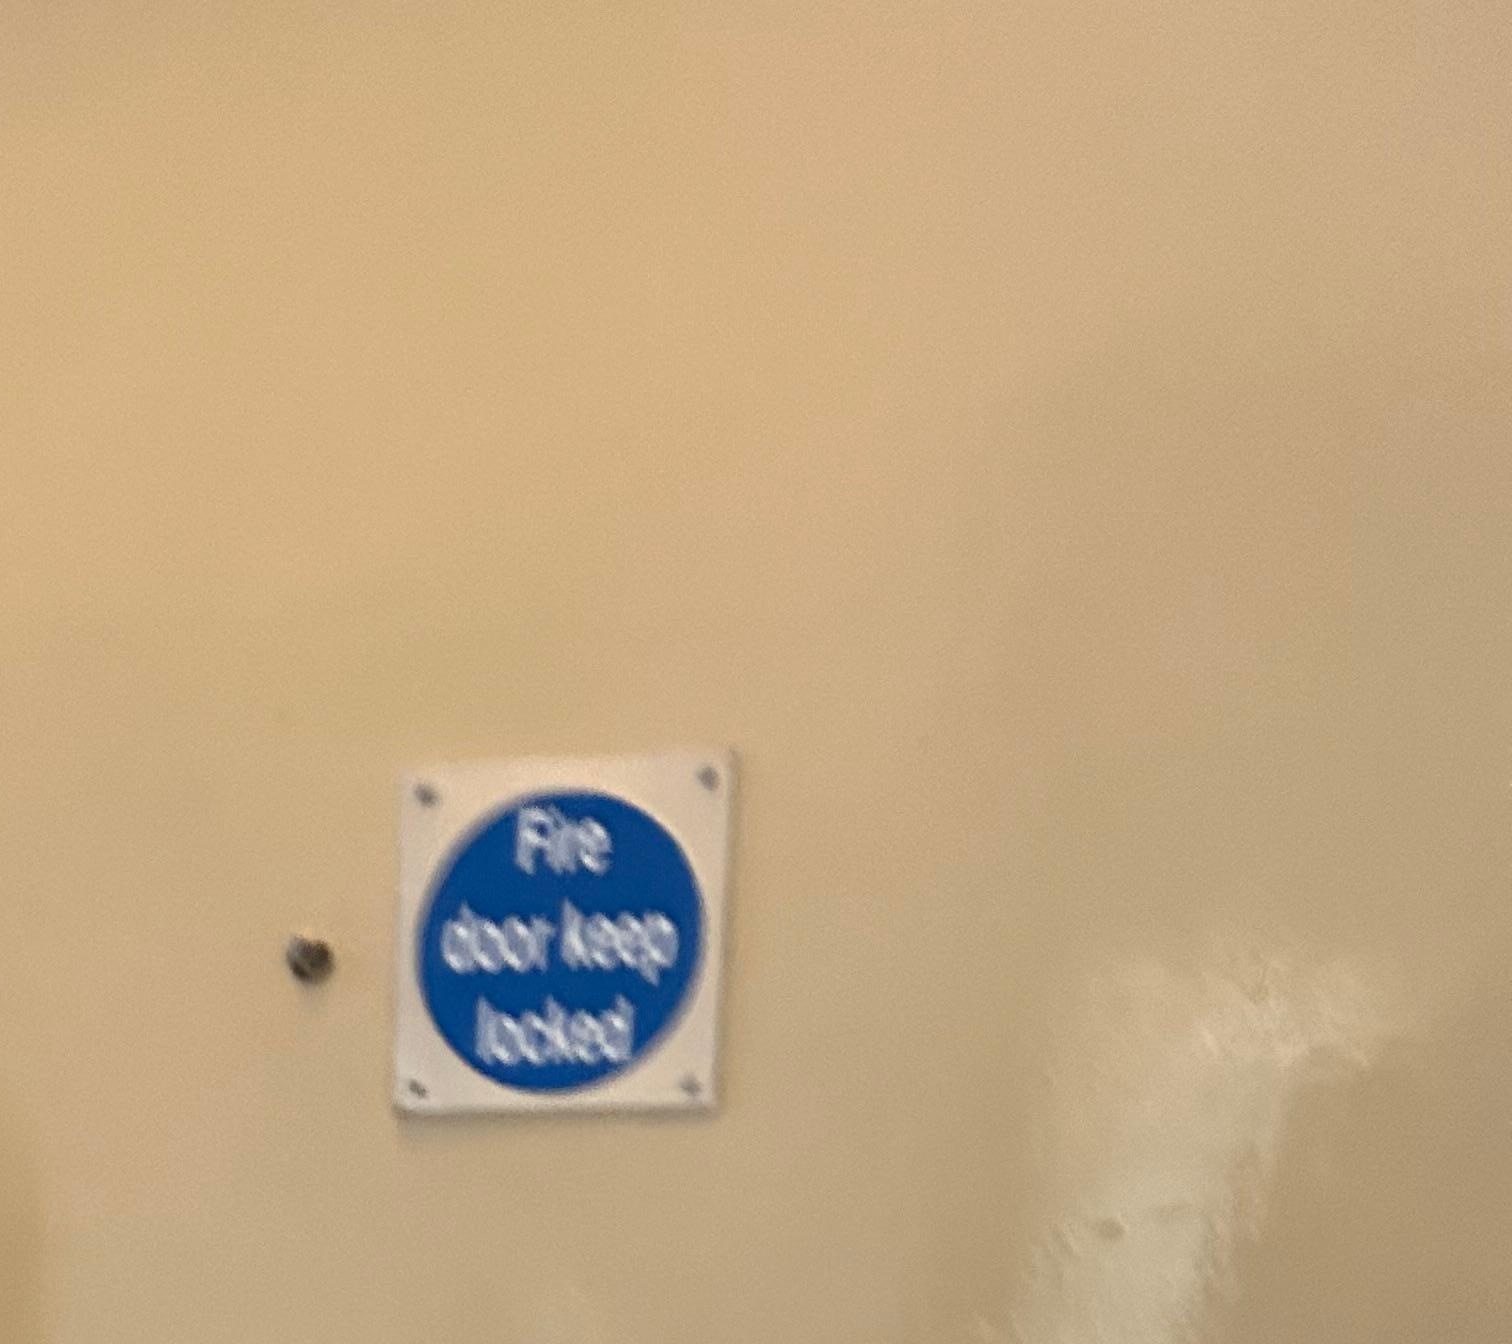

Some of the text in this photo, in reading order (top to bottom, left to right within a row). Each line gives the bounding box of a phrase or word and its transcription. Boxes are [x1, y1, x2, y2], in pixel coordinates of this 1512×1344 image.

[515, 804, 612, 875] Fire
[442, 899, 679, 986] door keep
[475, 995, 634, 1066] locked
